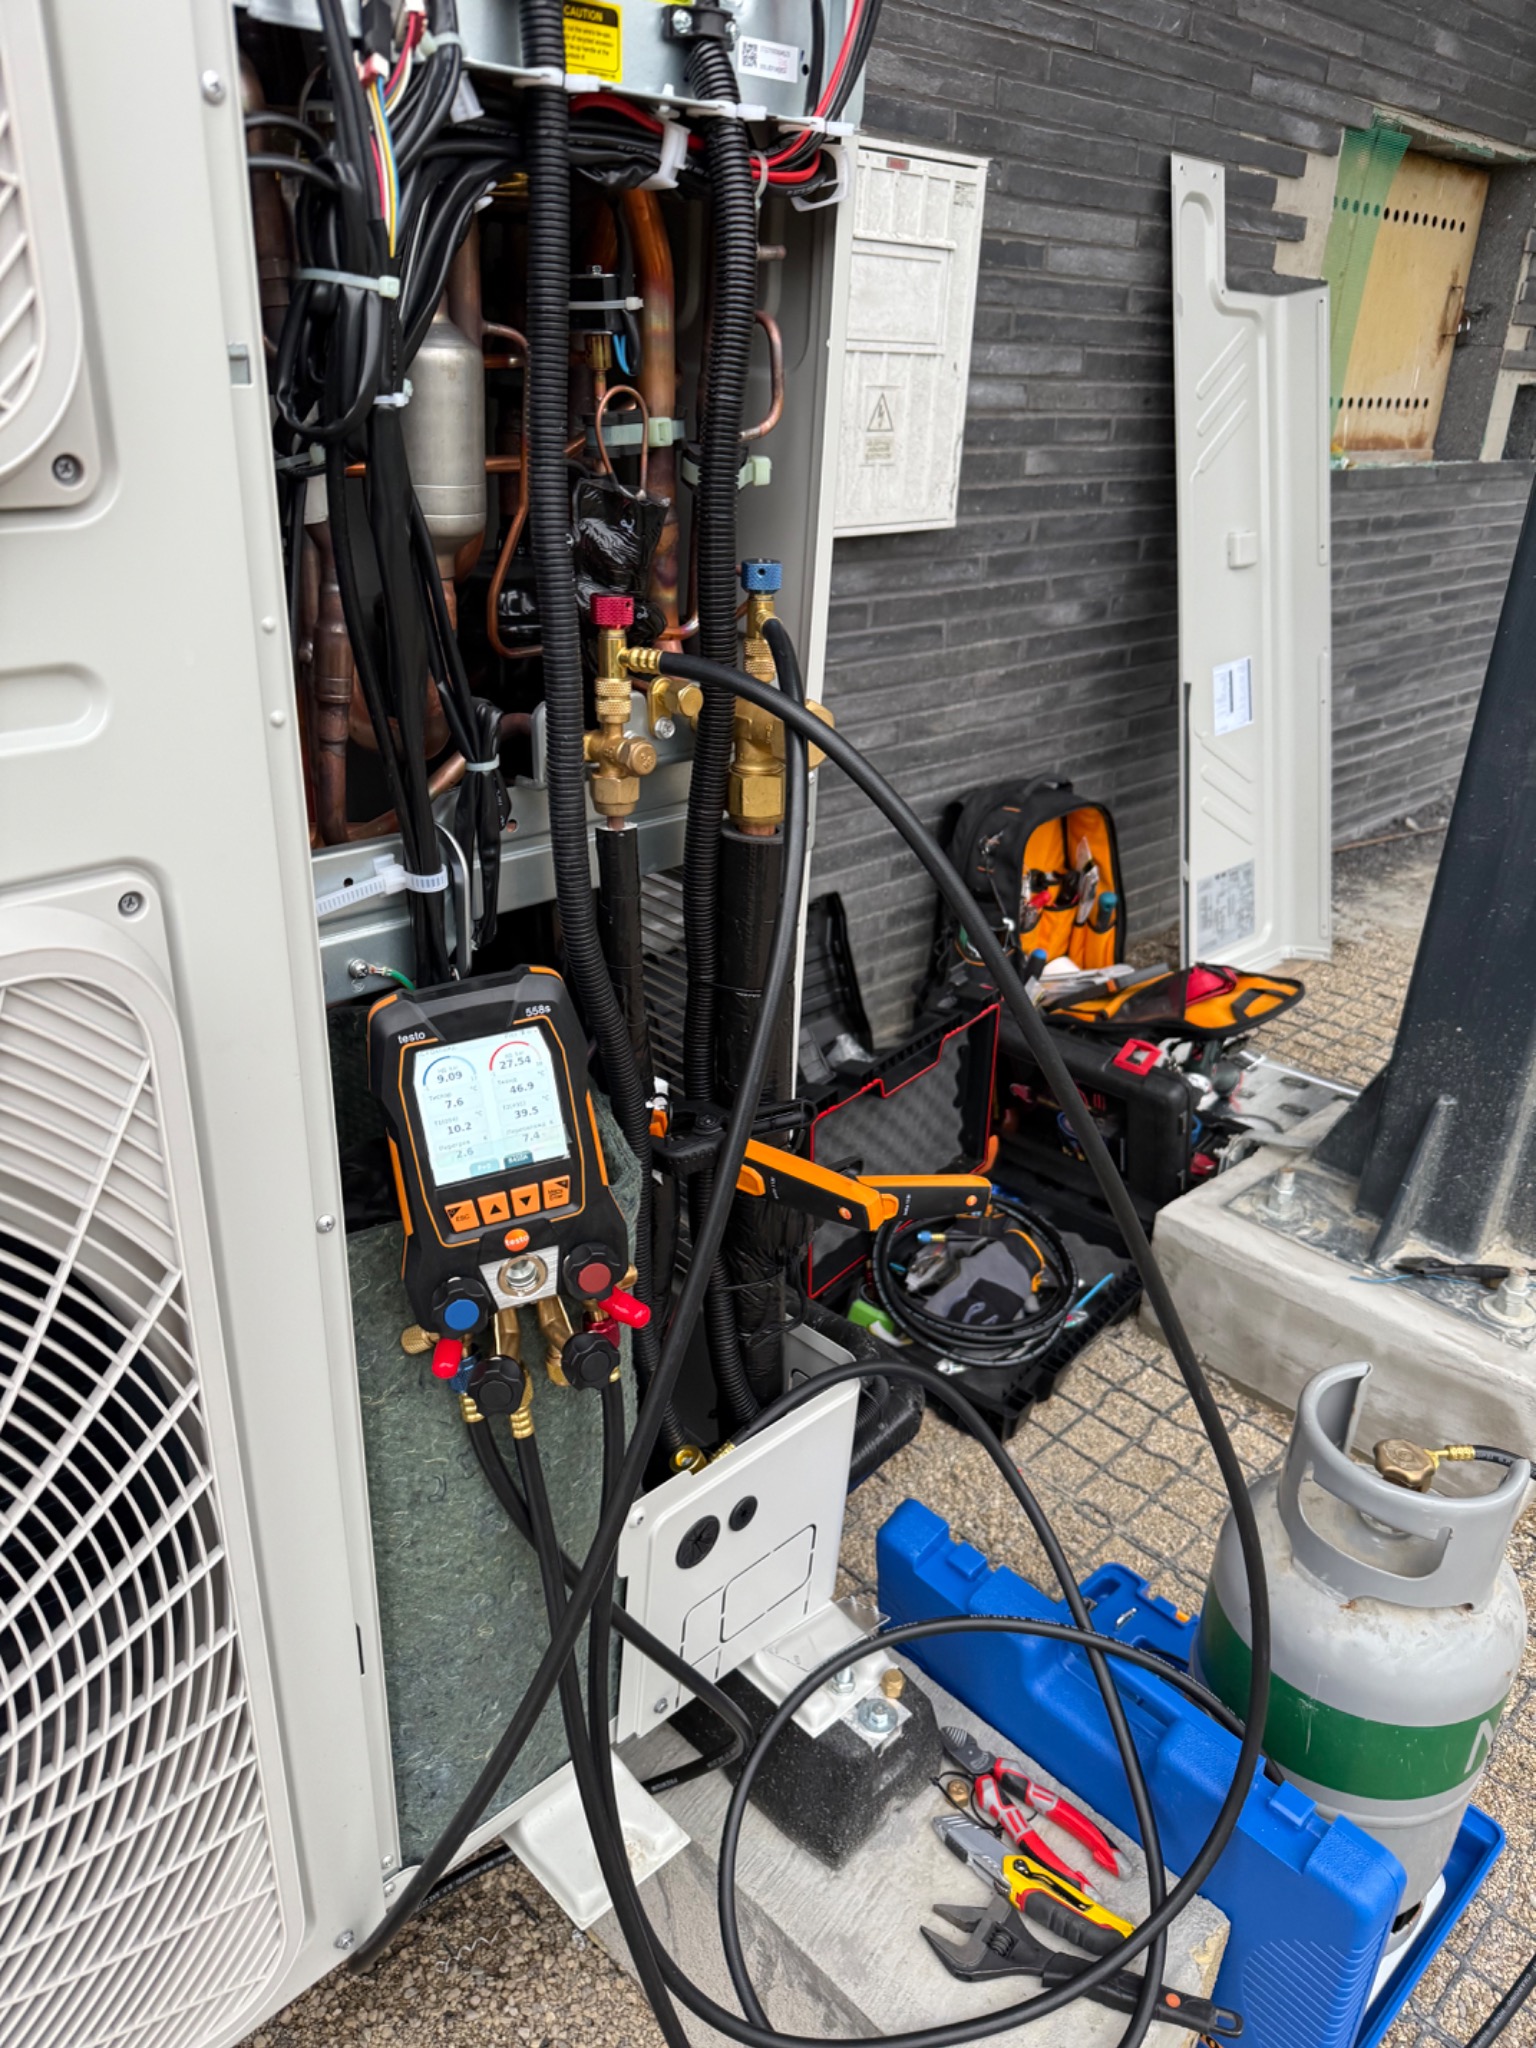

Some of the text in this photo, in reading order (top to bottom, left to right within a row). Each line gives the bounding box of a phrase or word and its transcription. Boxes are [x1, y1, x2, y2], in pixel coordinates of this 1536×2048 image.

[563, 5, 603, 22] CAUTION
[525, 1004, 551, 1017] 558s
[398, 1031, 425, 1044] testo
[499, 1055, 531, 1070] 27.54
[437, 1070, 463, 1084] 9.09
[509, 1081, 535, 1094] 46.9
[445, 1097, 464, 1109] 7.6
[514, 1106, 539, 1119] 39.5
[447, 1121, 472, 1135] 10.2
[522, 1131, 540, 1142] 7.4
[456, 1147, 474, 1159] 2.6
[504, 1233, 530, 1247] testo
